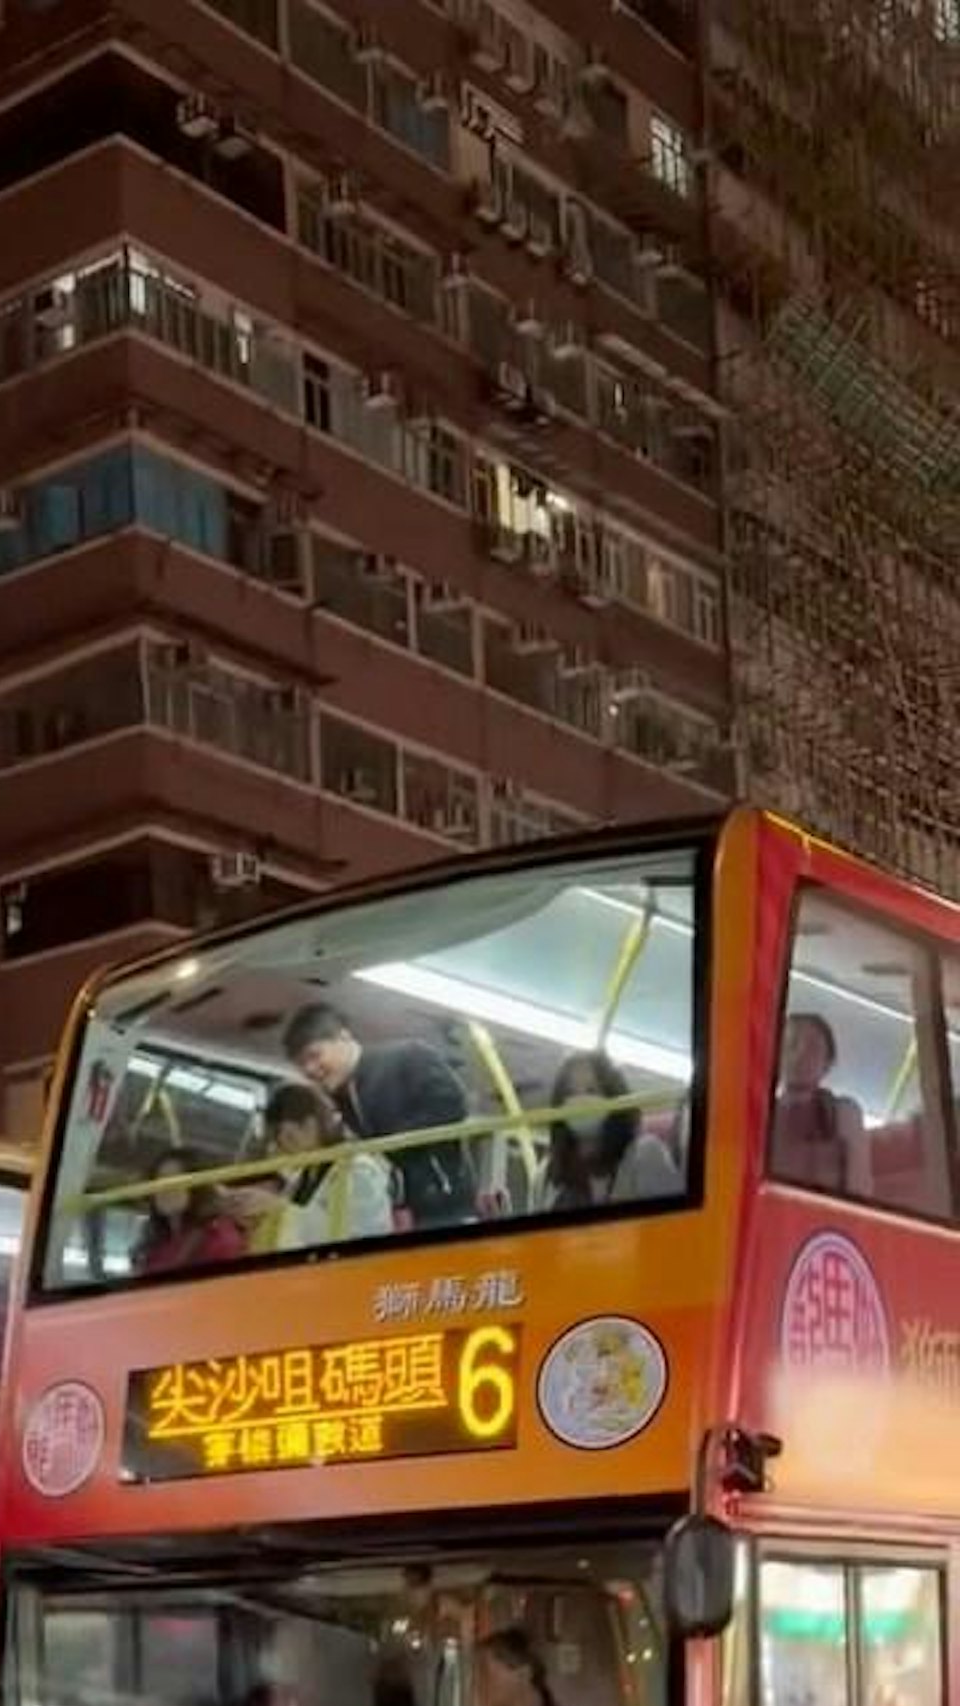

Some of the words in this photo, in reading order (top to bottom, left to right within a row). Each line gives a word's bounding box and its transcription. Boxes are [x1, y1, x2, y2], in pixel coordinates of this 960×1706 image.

[151, 1333, 446, 1430] 尖沙咀碼頭
[458, 1326, 514, 1436] 6
